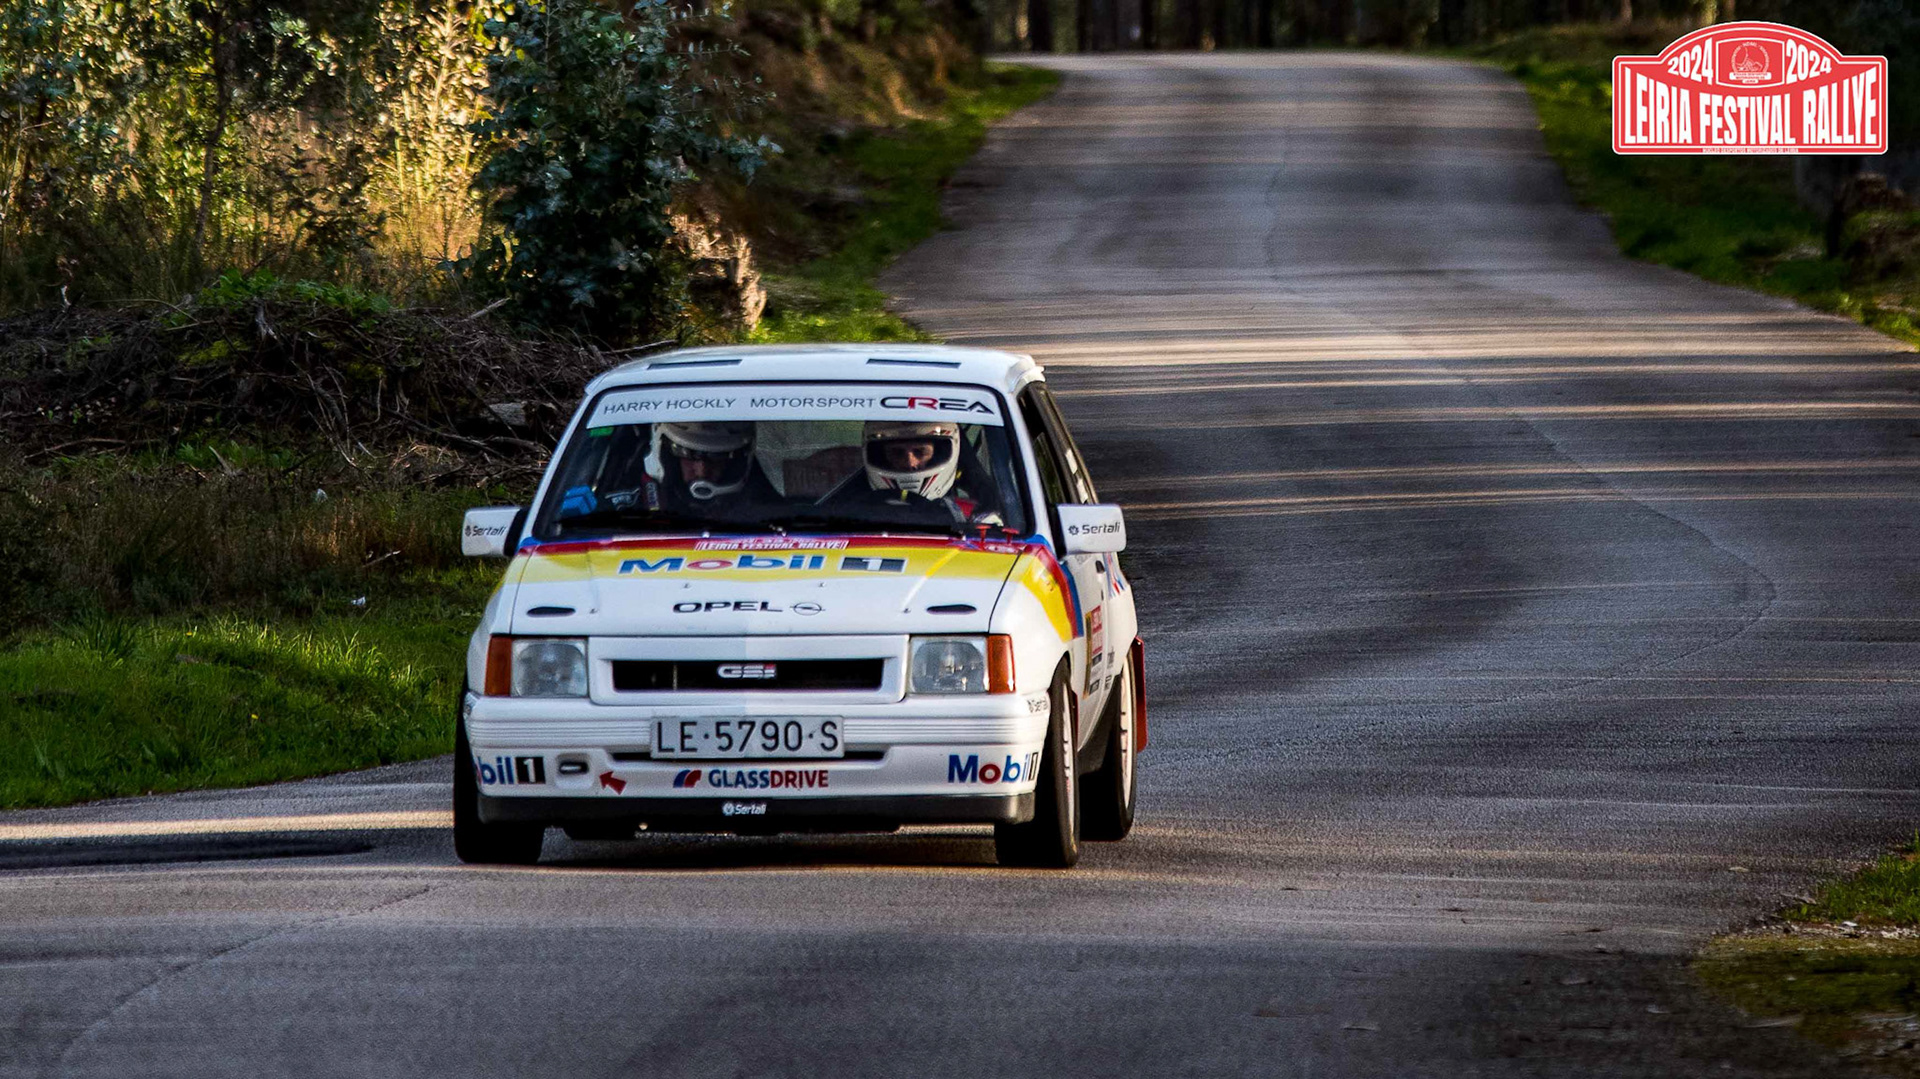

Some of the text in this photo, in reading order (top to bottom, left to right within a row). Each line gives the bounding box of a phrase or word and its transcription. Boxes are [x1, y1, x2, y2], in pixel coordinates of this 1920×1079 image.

[603, 395, 995, 415] HARRY HOCKLY MOTORSPORT CREA
[471, 525, 507, 537] Sertali
[1081, 521, 1121, 535] Sertali
[701, 540, 841, 551] LEIRIA FESTIVAL RALLYE
[617, 554, 825, 575] Mobil
[672, 600, 783, 614] OPEL
[476, 756, 515, 785] bil
[948, 753, 1030, 784] Mobil
[708, 768, 829, 789] GLASSDRIVE
[734, 803, 767, 815] Sertali
